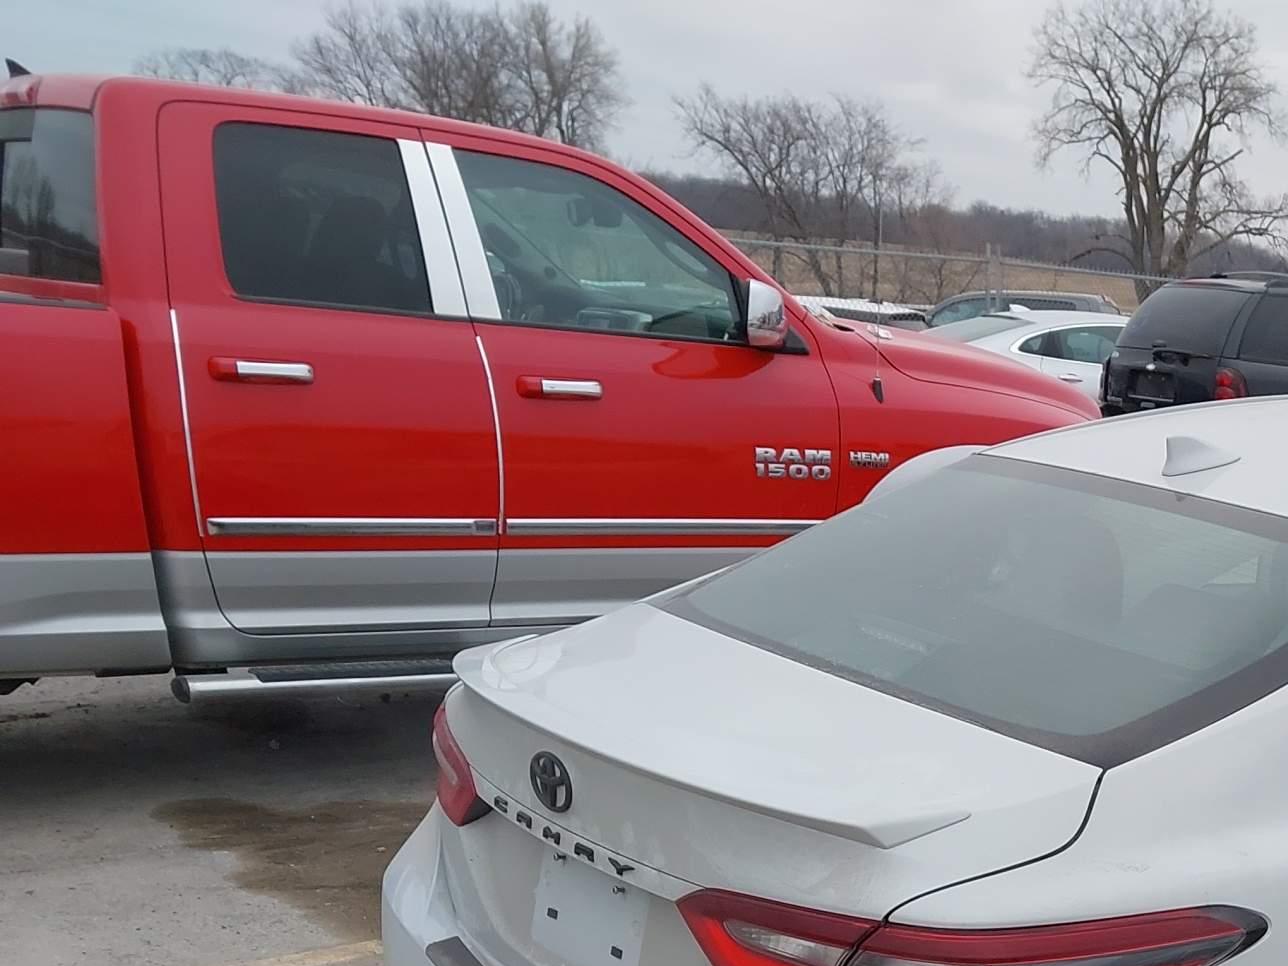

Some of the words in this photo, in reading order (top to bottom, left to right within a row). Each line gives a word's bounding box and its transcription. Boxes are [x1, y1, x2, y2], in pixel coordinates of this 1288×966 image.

[754, 446, 832, 464] RAM
[849, 451, 890, 463] HEMI
[754, 463, 832, 480] 1500
[493, 795, 636, 877] CAMRY
